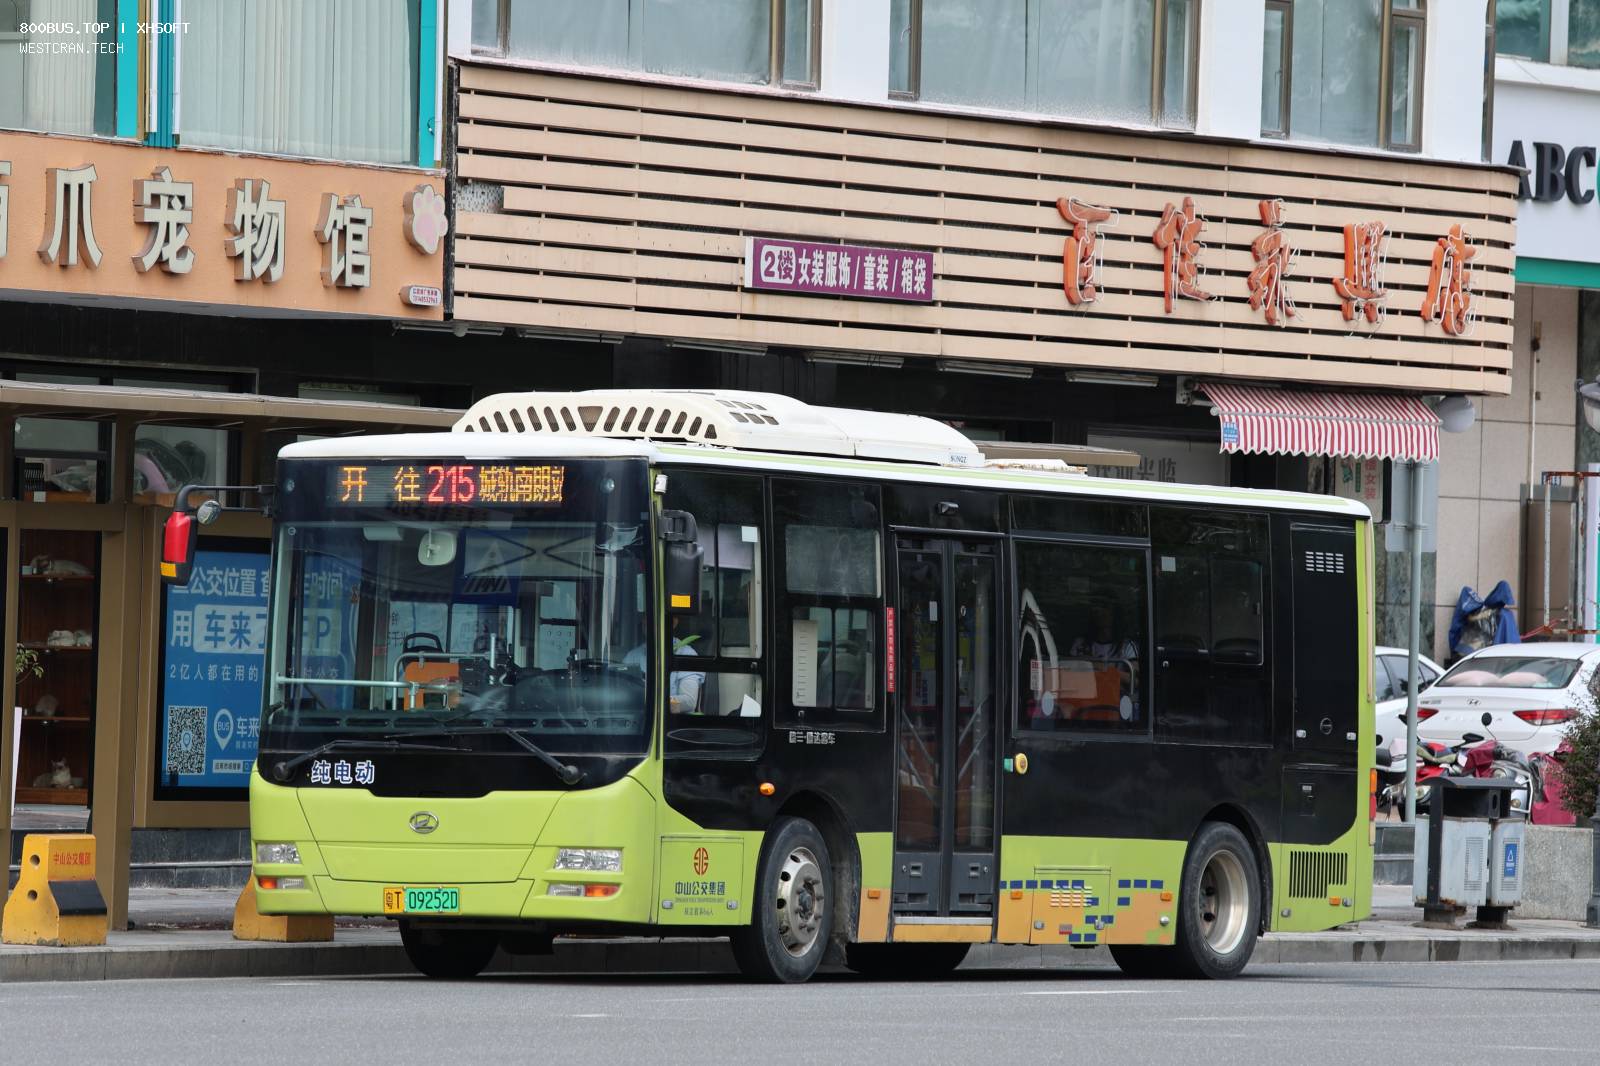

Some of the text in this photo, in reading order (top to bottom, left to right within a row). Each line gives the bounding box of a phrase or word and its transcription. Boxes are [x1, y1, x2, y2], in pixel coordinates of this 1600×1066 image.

[1507, 139, 1597, 205] ABC
[763, 249, 795, 281] 2楼
[342, 466, 368, 502] 开
[394, 466, 421, 502] 往
[427, 466, 475, 502] 215
[170, 663, 259, 682] 2亿人都在用的
[311, 760, 375, 784] 纯电动
[675, 881, 726, 896] 中山公交集团
